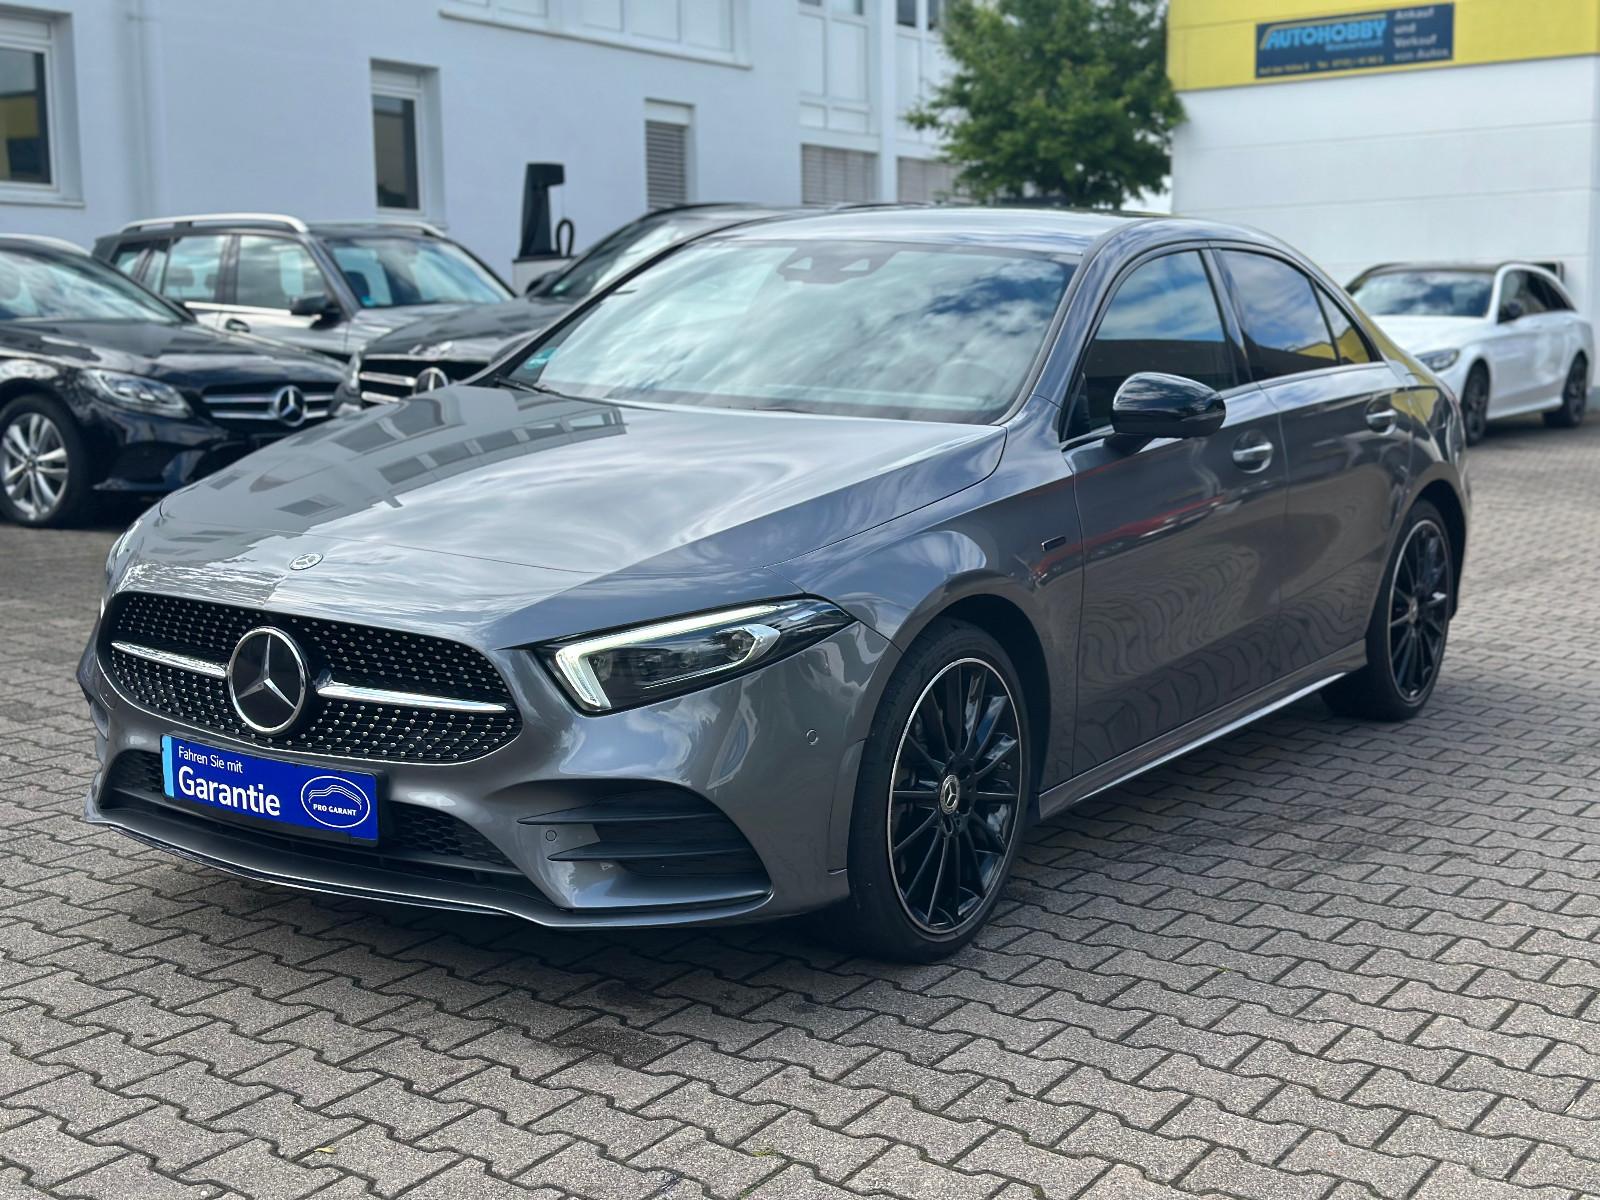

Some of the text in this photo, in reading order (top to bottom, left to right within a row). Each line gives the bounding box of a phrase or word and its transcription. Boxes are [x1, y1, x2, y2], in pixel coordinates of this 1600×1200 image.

[1266, 19, 1387, 50] AUTOHOBBY
[178, 745, 243, 774] Fahren Sie mit
[178, 765, 281, 816] Garantie
[313, 803, 356, 816] PRO GARANT
